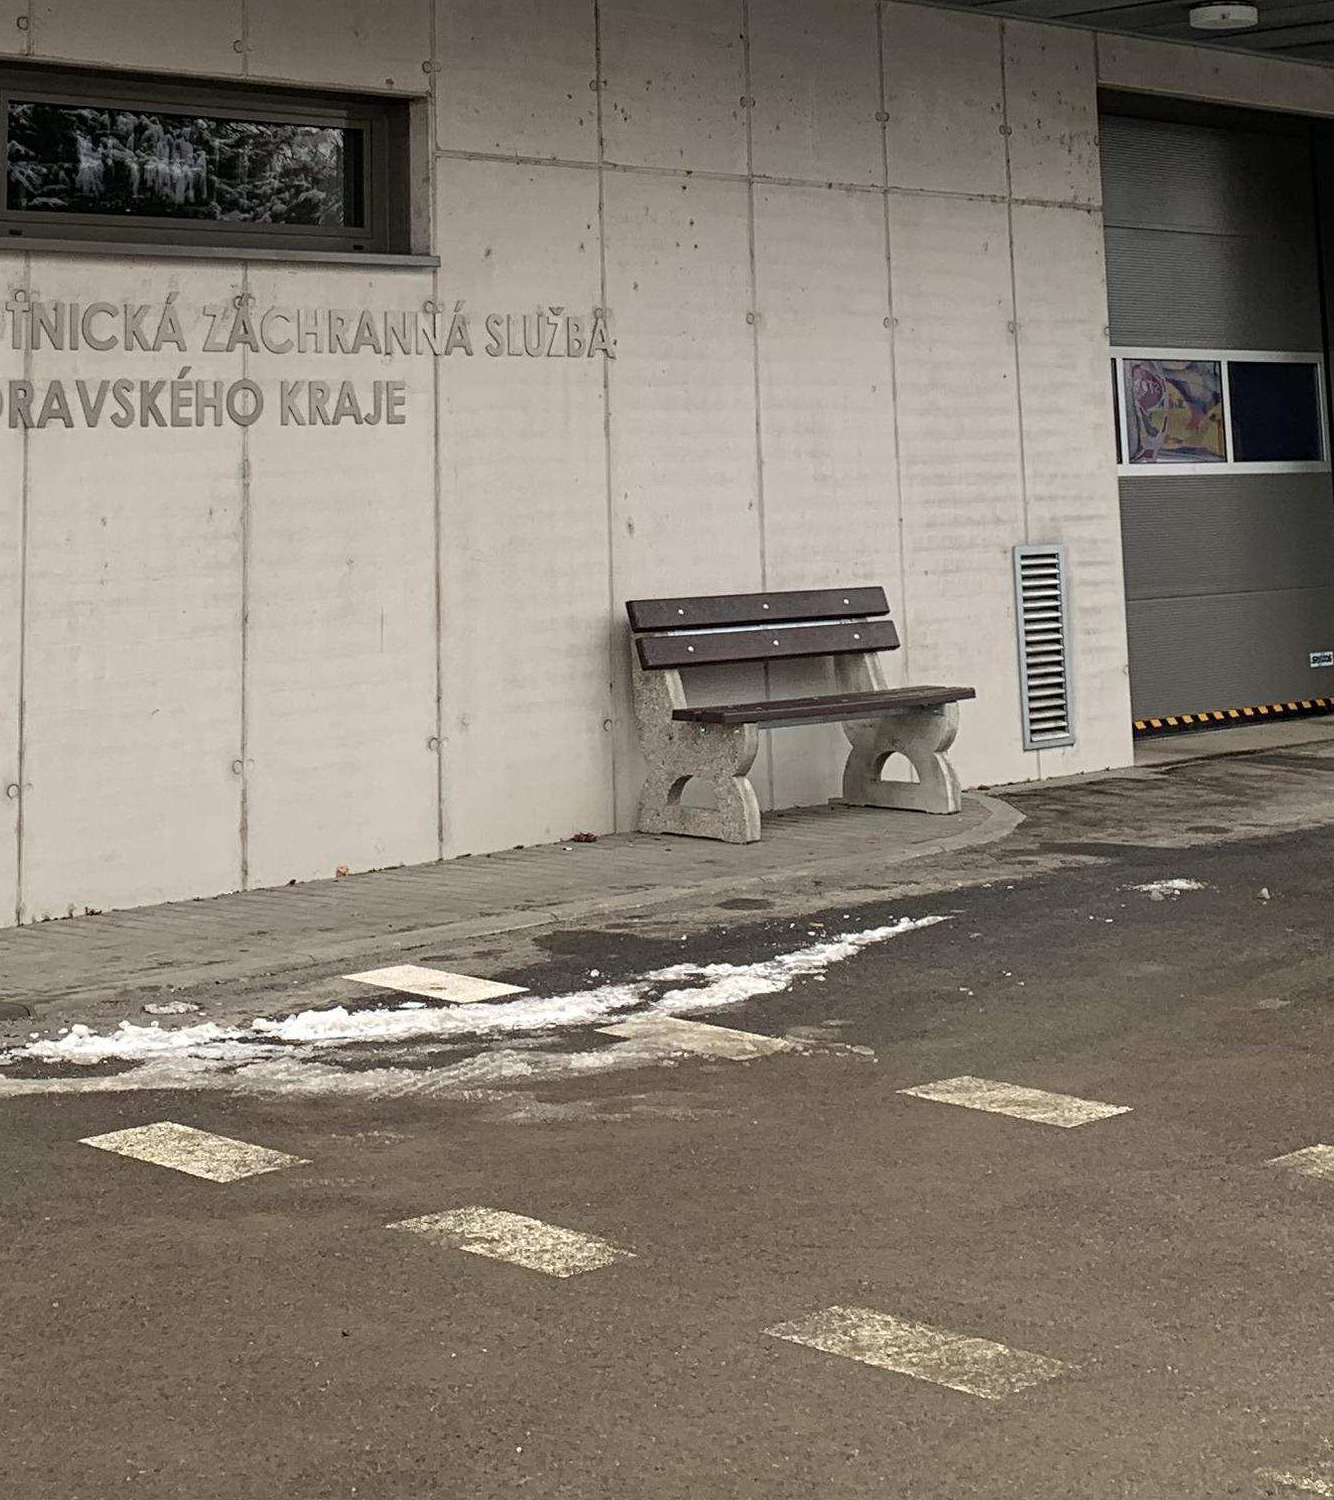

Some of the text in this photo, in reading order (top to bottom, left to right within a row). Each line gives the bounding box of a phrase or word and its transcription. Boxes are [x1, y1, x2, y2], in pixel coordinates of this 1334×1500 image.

[202, 293, 474, 357] ZÁCHRANNÁ
[484, 306, 617, 360] SLUŽBA
[279, 380, 407, 426] KRAJE
